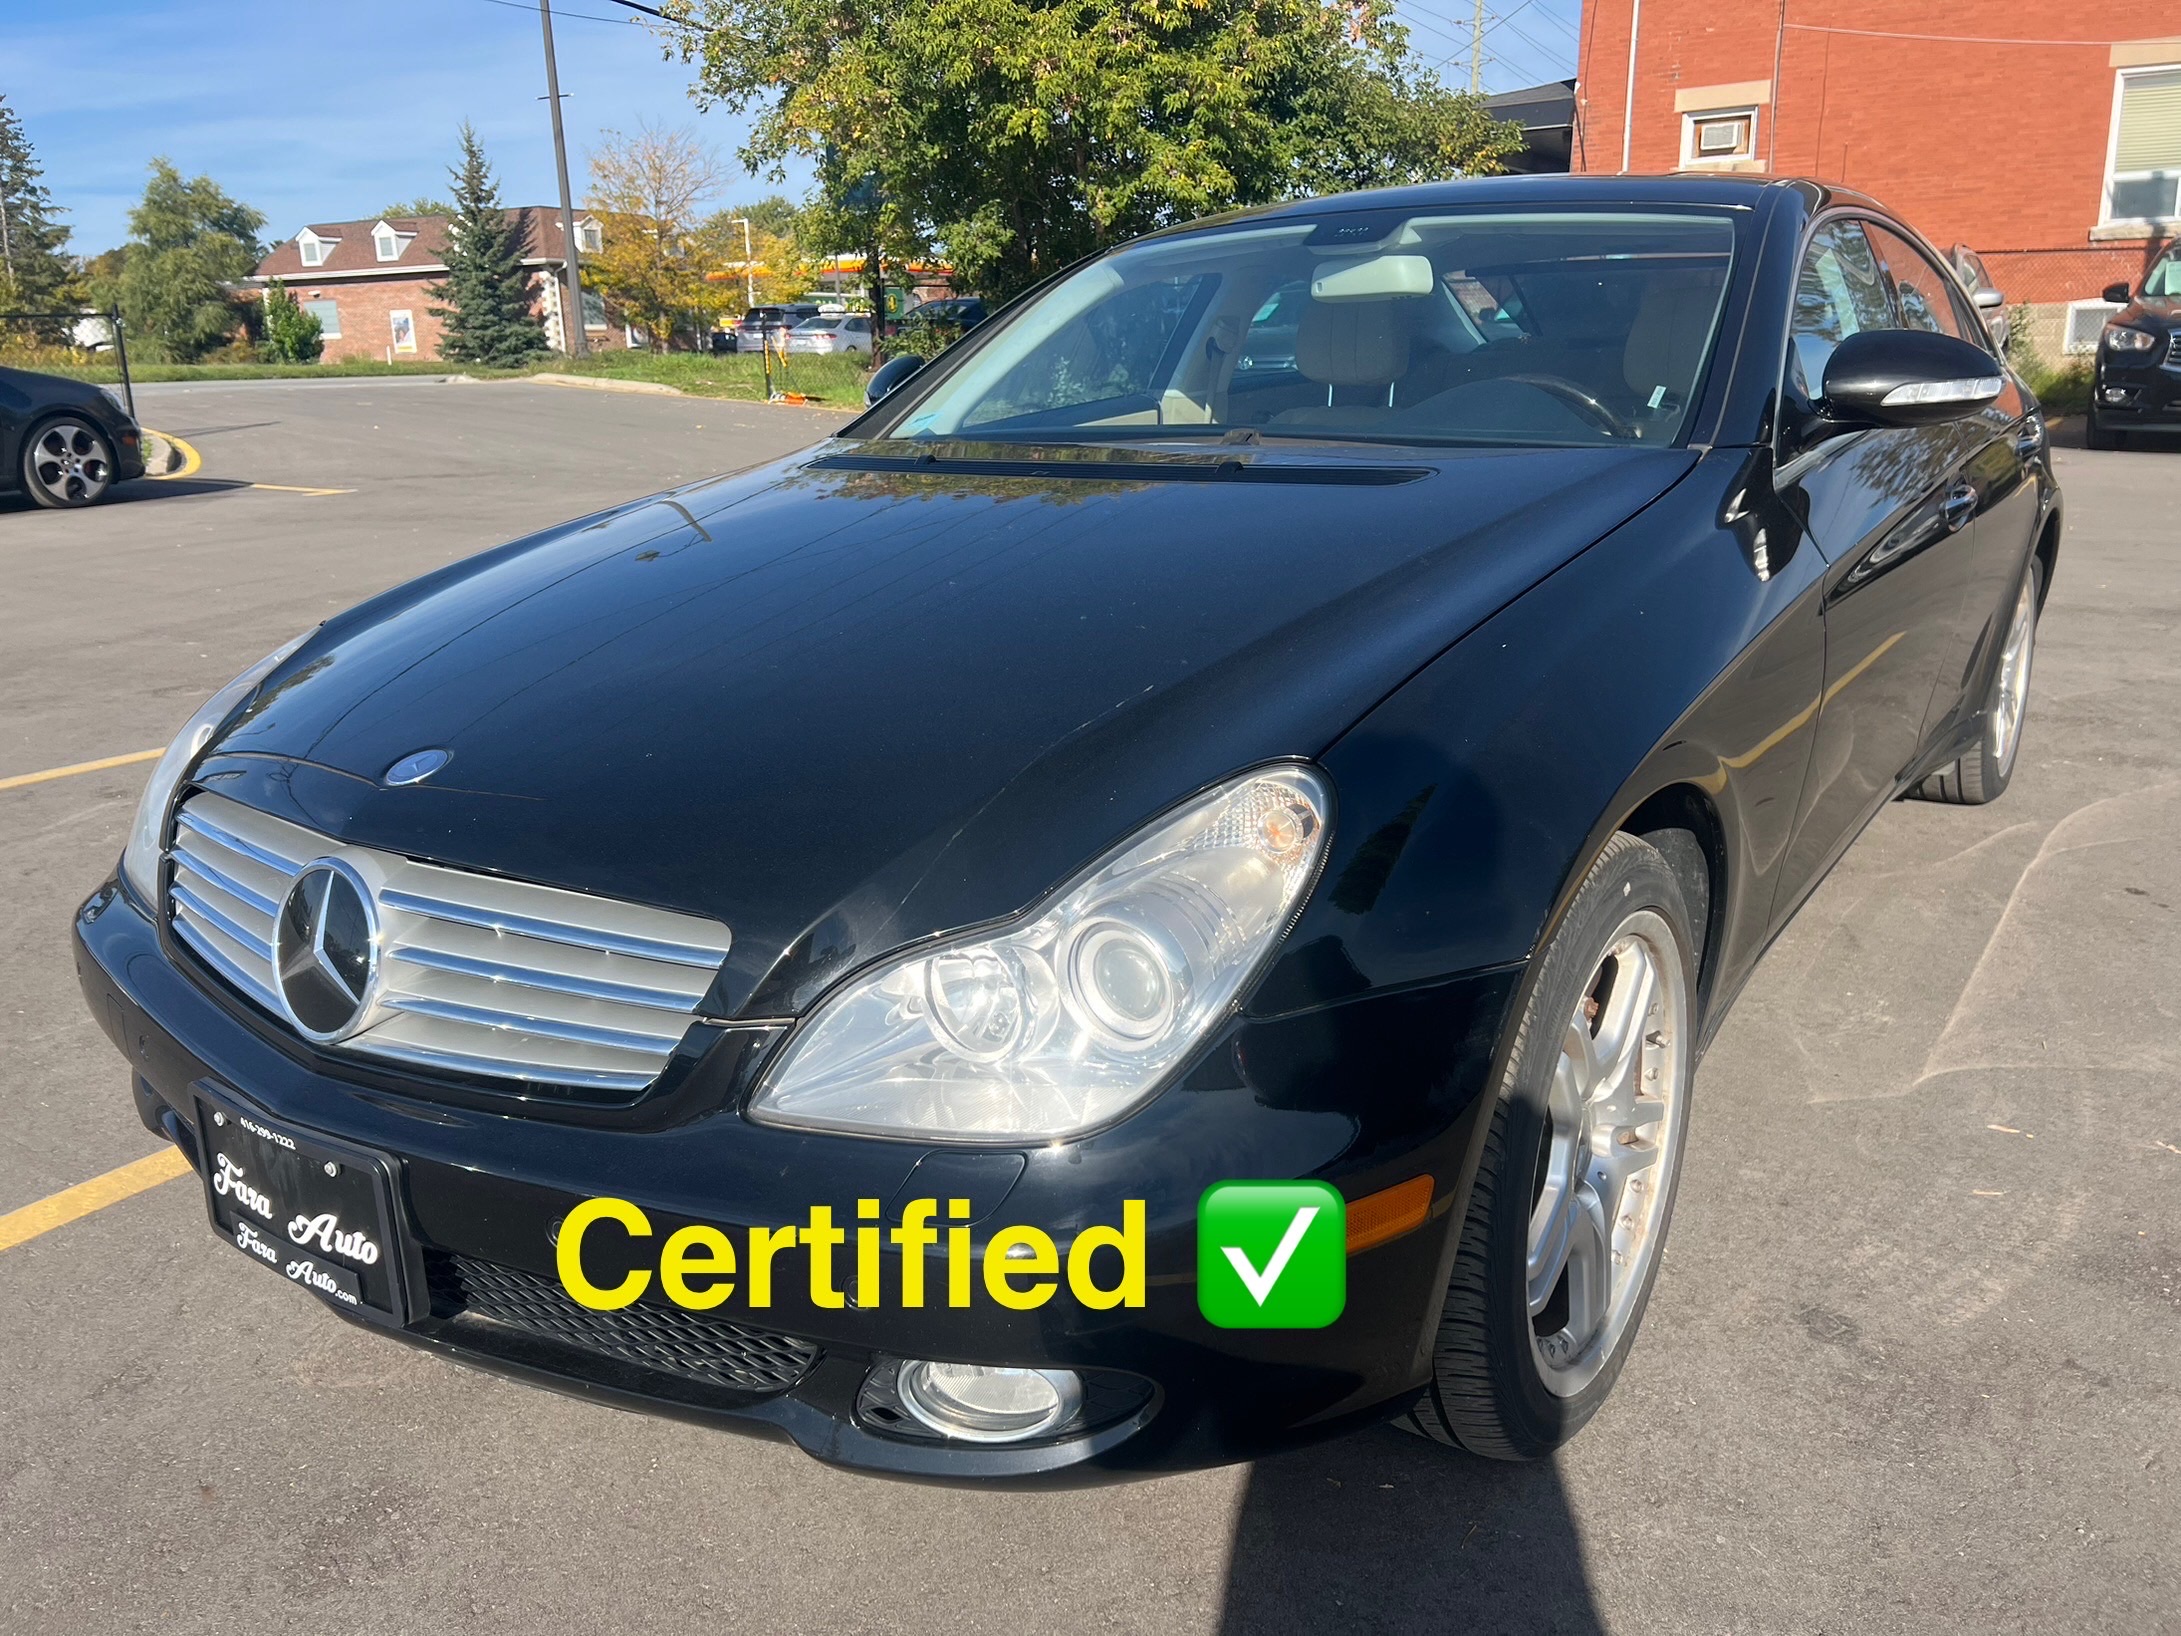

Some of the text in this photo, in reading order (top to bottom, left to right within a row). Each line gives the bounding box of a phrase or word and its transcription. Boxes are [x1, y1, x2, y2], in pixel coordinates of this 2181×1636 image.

[213, 1152, 378, 1264] Fara Auto
[236, 1222, 278, 1264] Fara
